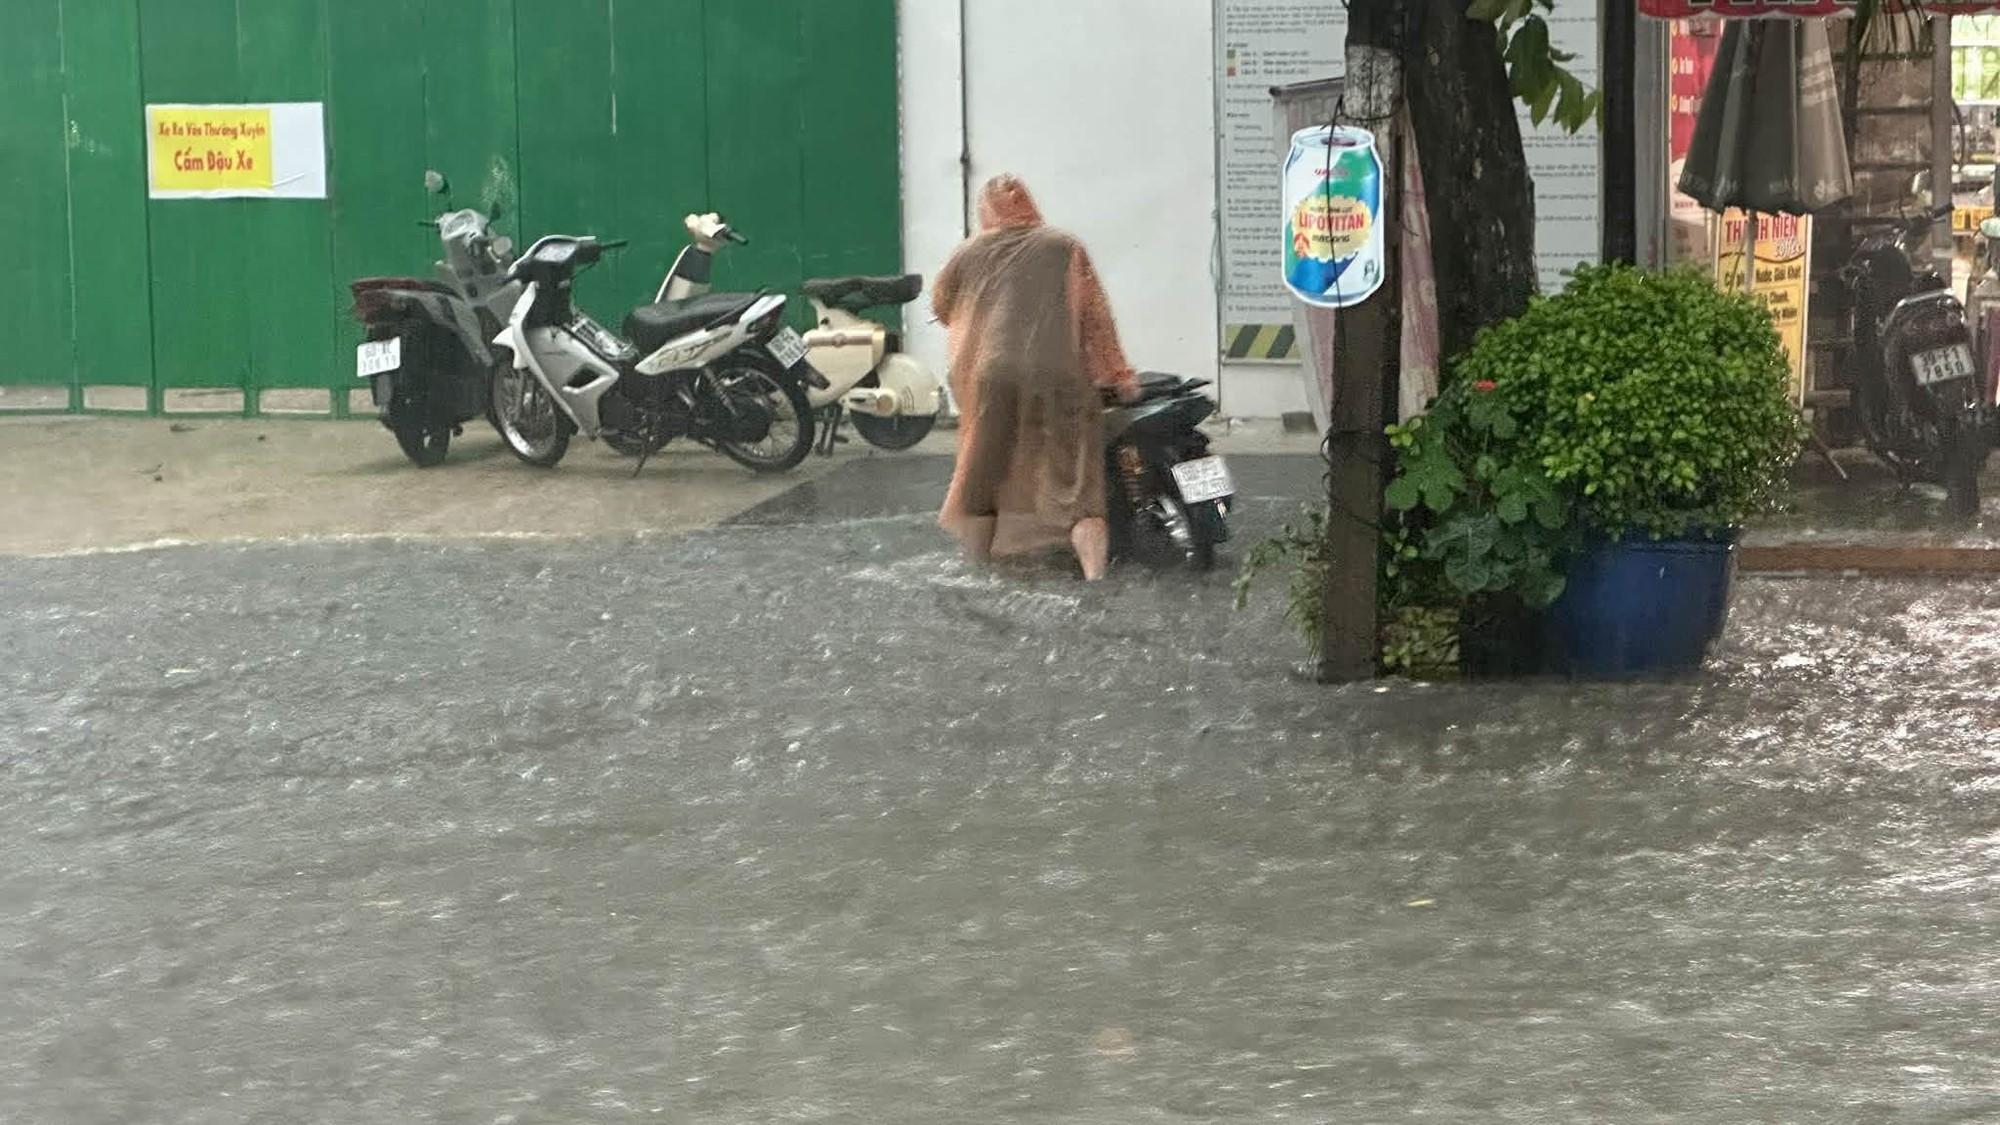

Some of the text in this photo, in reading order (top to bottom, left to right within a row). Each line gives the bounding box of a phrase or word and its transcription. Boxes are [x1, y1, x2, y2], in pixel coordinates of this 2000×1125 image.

[158, 122, 170, 136] Xe
[173, 146, 254, 175] Cấm Đậu Xe
[1298, 212, 1364, 231] LIPOVITAN
